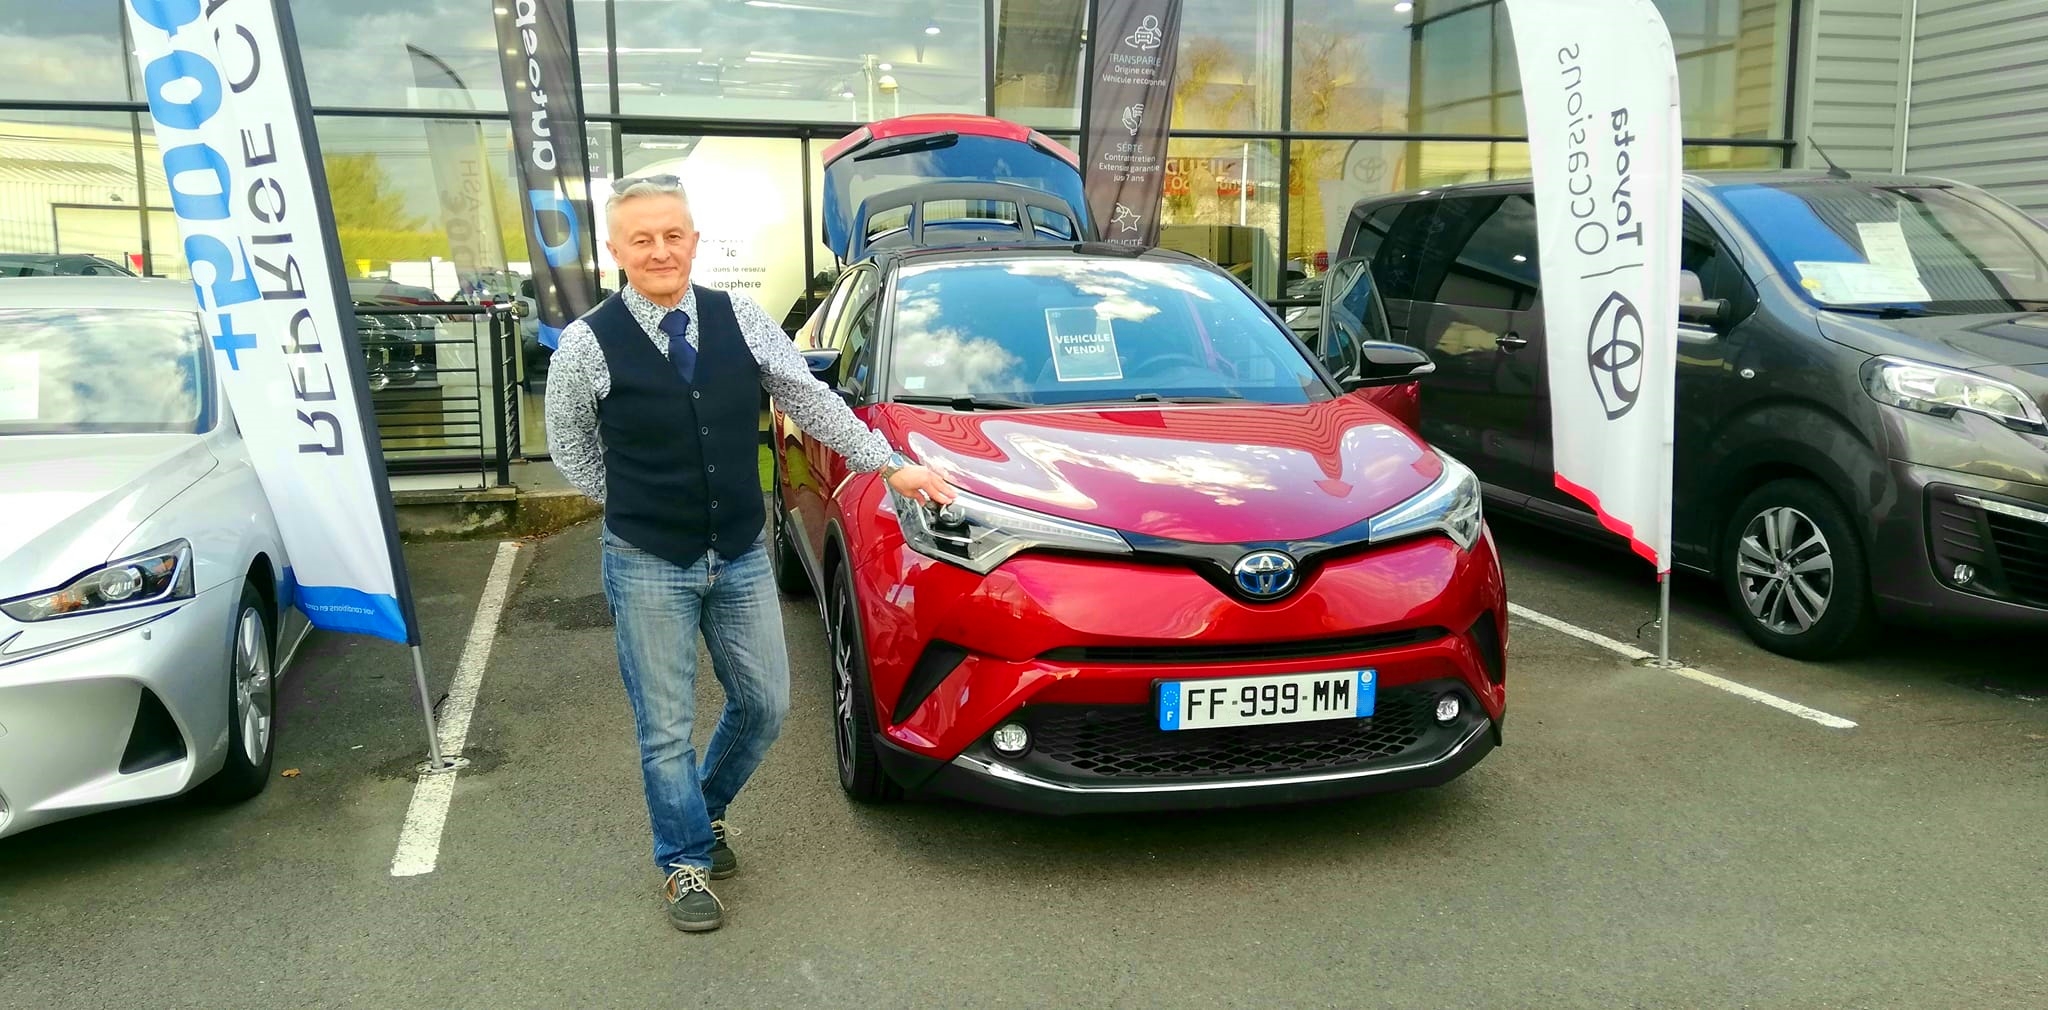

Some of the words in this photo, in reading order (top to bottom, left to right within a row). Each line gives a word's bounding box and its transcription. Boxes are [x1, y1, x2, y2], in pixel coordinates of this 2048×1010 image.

[1115, 65, 1140, 74] Origine
[1055, 333, 1111, 344] VEHICULE
[1064, 344, 1105, 355] VENDU
[1187, 679, 1350, 721] FF-999-MM
[1166, 711, 1174, 722] F
